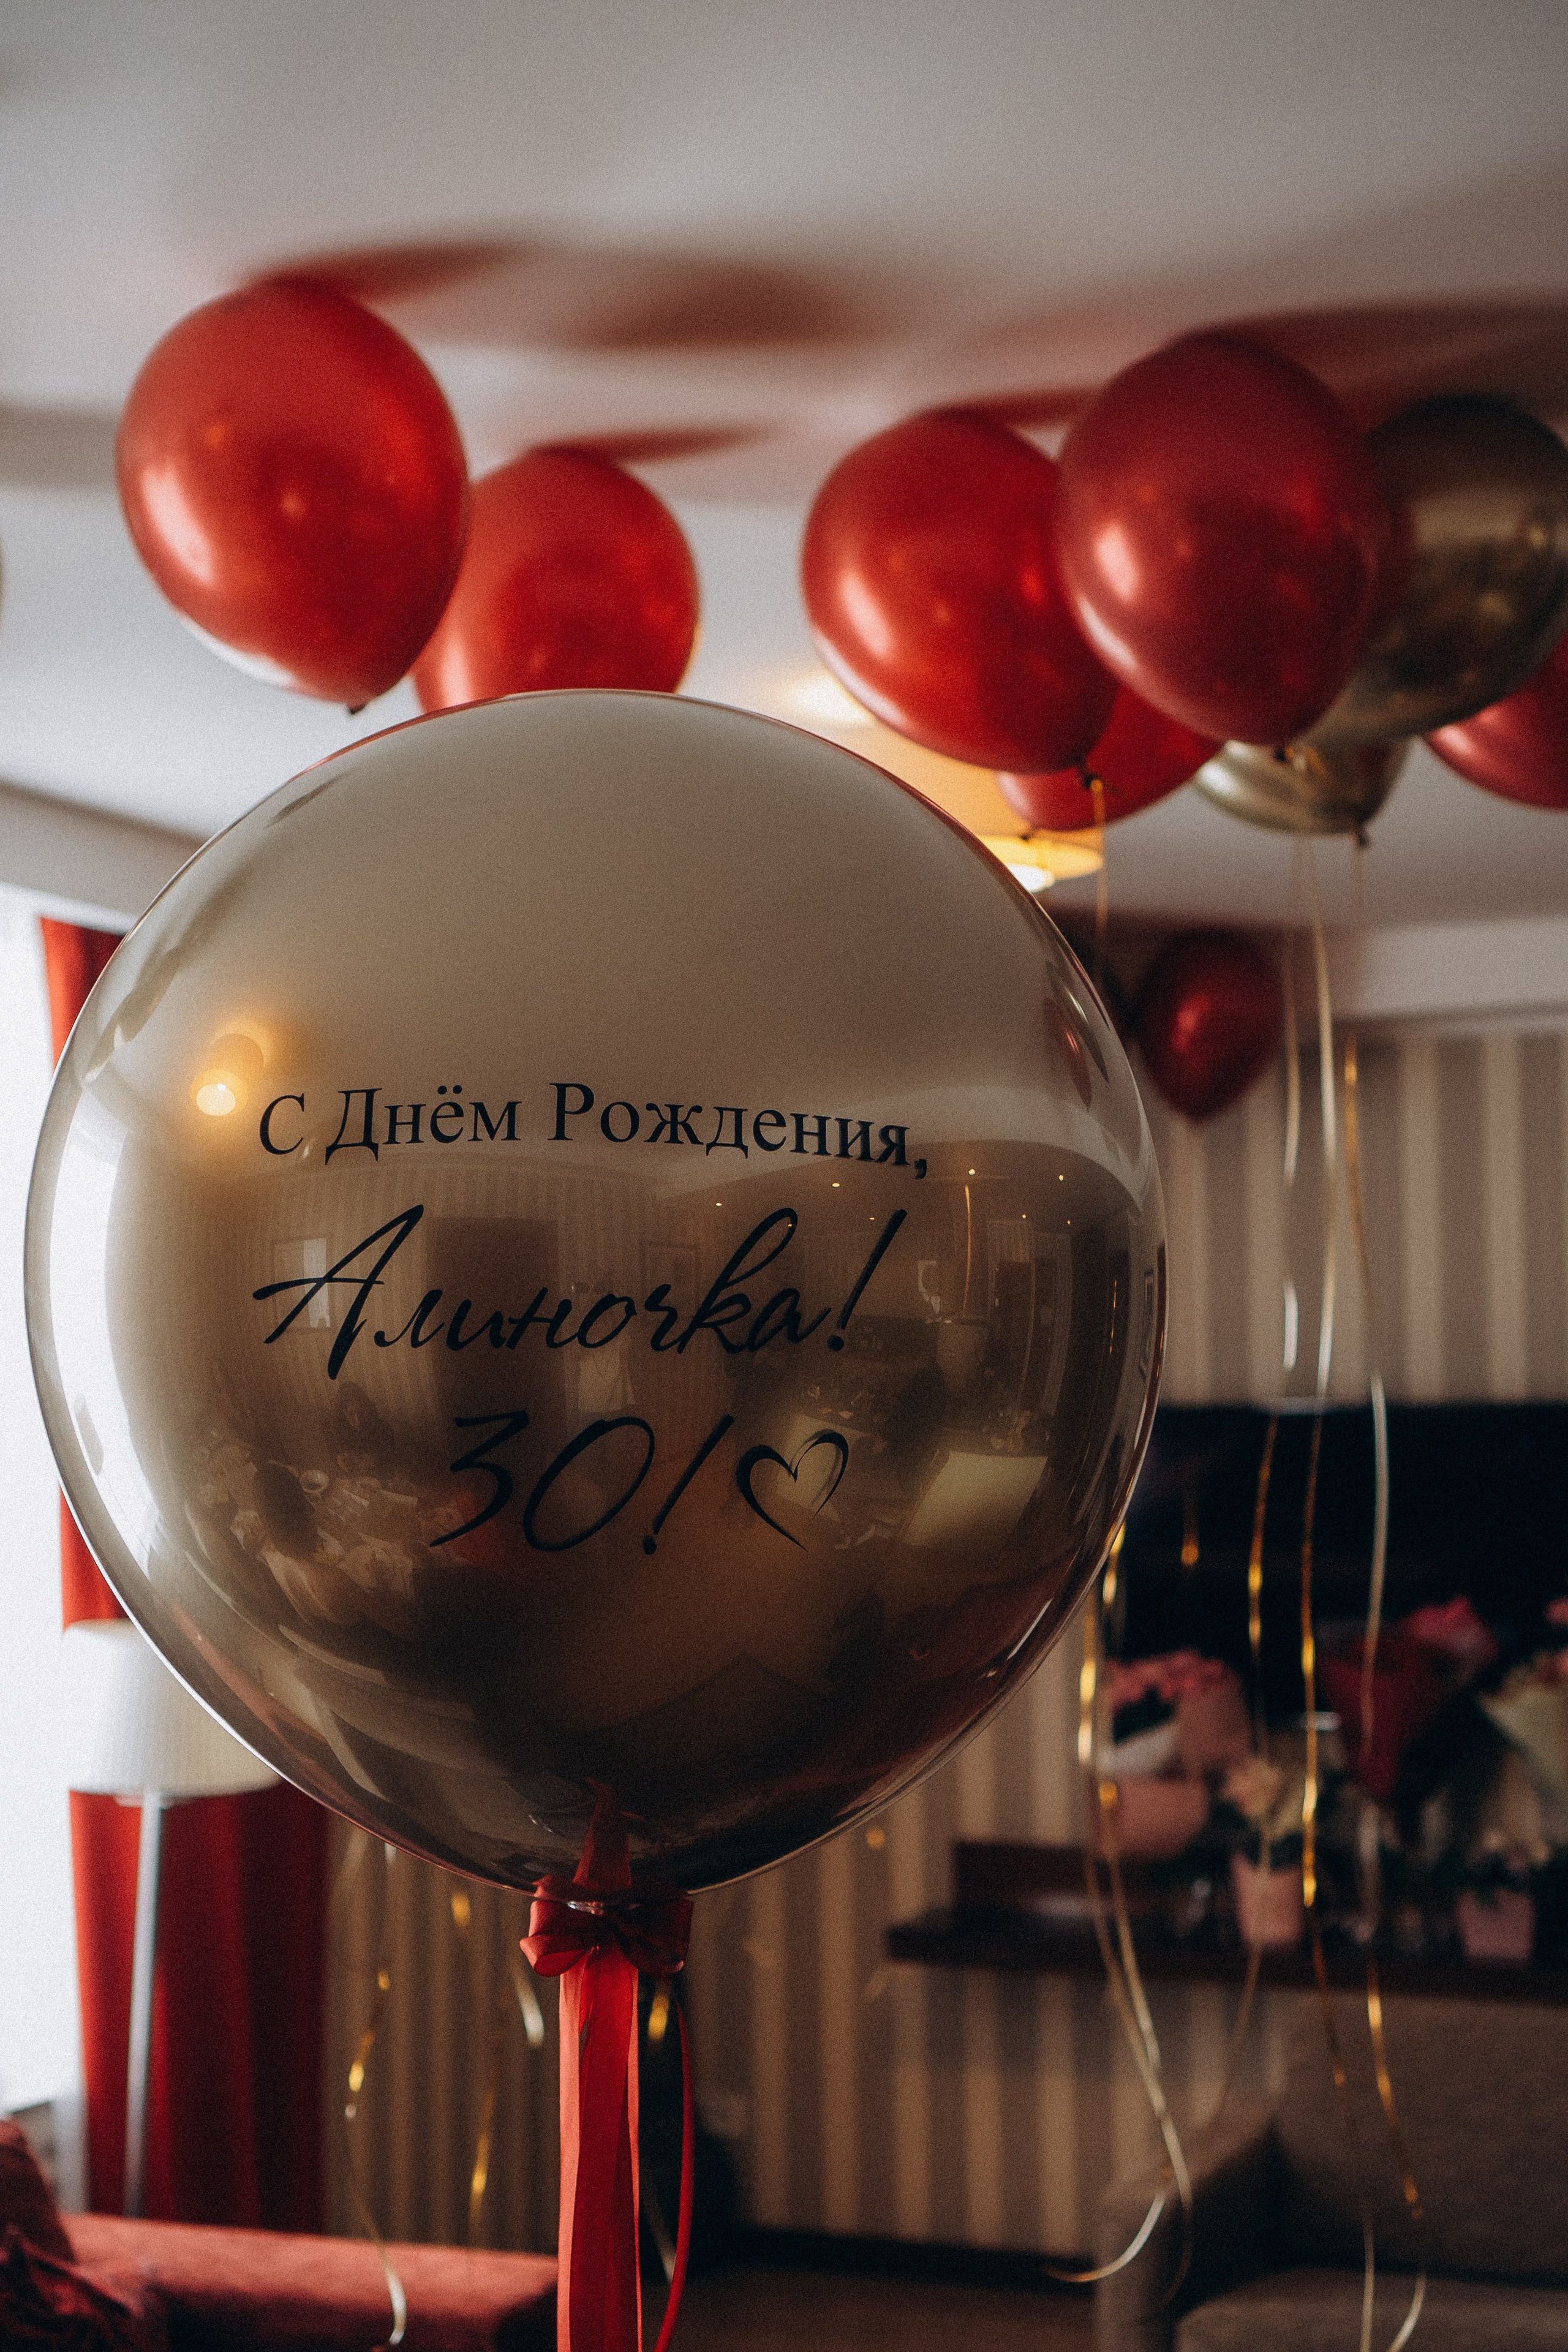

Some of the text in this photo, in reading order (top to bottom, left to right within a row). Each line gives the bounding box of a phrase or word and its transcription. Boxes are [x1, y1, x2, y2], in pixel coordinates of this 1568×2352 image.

[259, 1082, 928, 1179] С Днём Рождения,
[252, 1204, 907, 1381] Алиночка!
[429, 1410, 734, 1555] 30!
